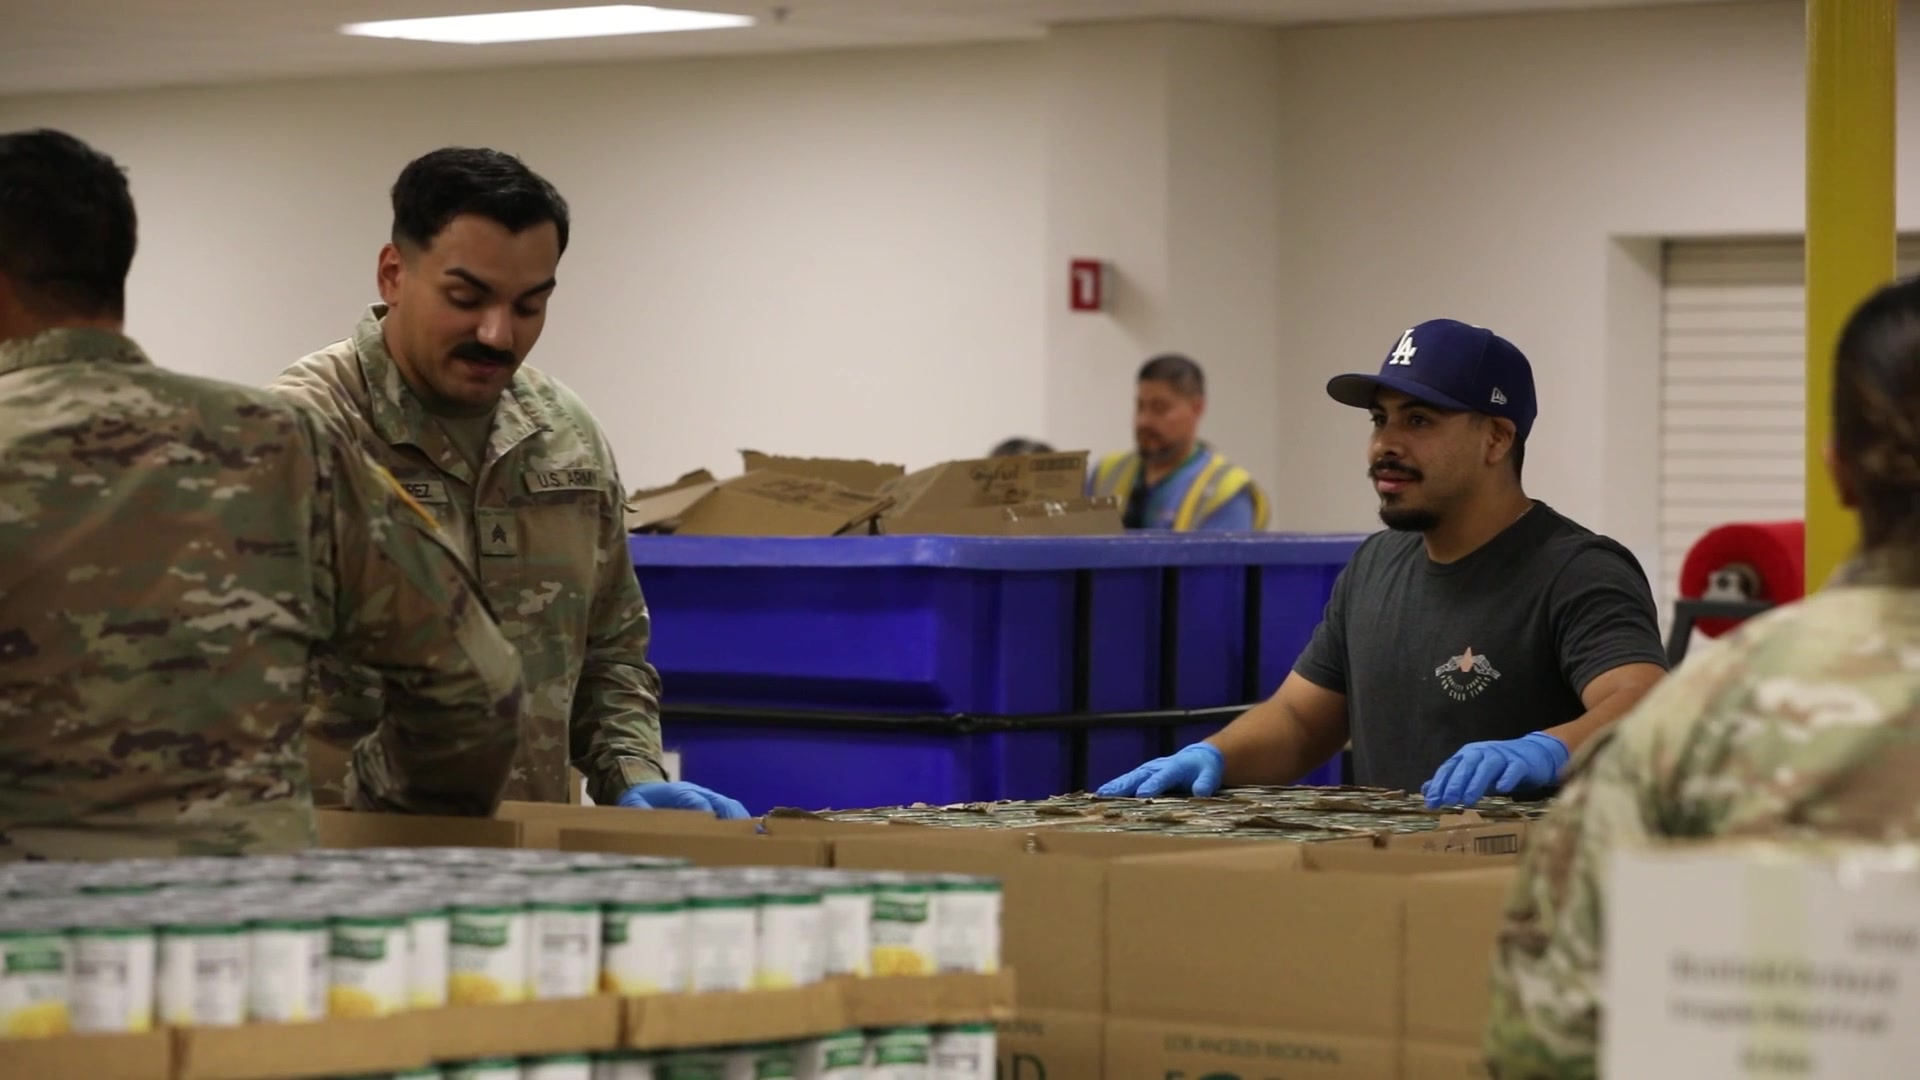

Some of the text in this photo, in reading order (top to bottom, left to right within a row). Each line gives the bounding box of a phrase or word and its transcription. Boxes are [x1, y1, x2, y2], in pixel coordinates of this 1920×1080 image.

[1389, 328, 1417, 366] LA
[537, 470, 597, 488] U.S. ARMY
